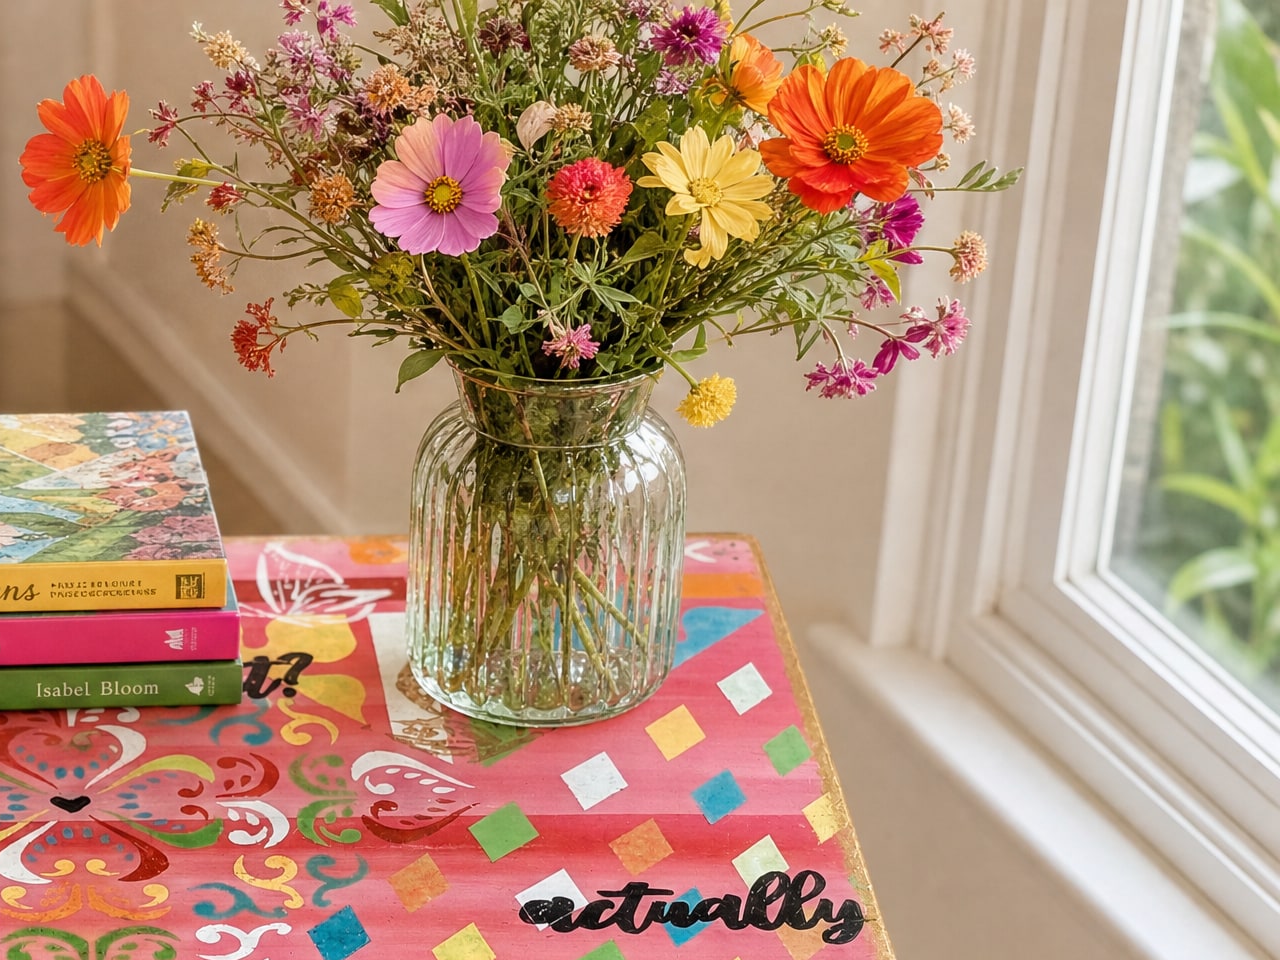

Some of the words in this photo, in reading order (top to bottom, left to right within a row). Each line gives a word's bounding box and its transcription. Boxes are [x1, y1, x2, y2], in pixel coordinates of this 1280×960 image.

[36, 681, 91, 698] Isabel
[100, 680, 159, 696] Bloom
[518, 869, 865, 945] actually
